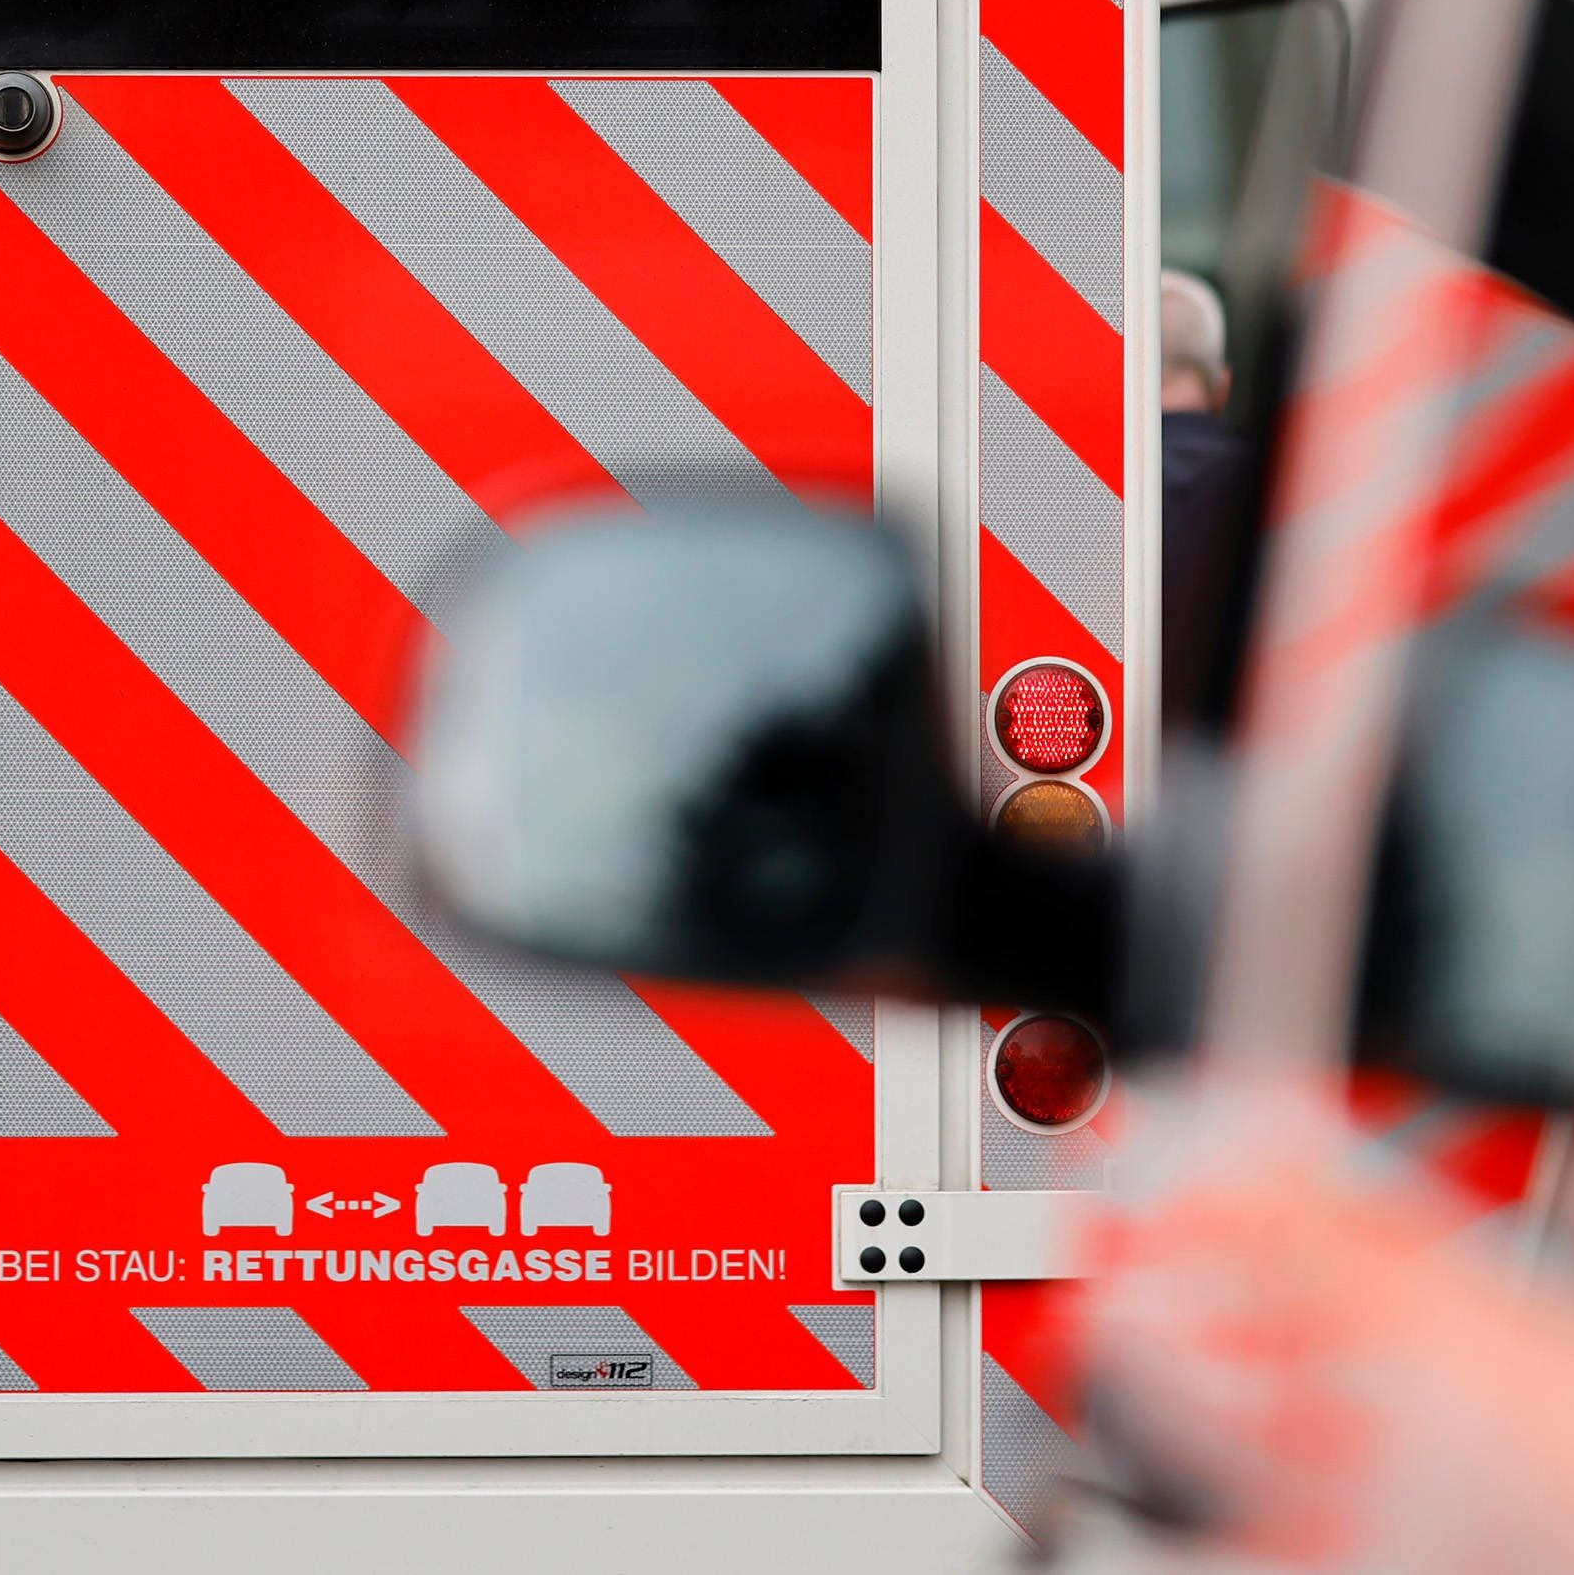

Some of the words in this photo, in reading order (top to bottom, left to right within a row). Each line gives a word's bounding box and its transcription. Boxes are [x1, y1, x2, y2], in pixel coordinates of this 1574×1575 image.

[76, 1250, 185, 1282] STAU:
[204, 1249, 611, 1282] RETTUNGSGASSE
[629, 1249, 785, 1281] BILDEN!
